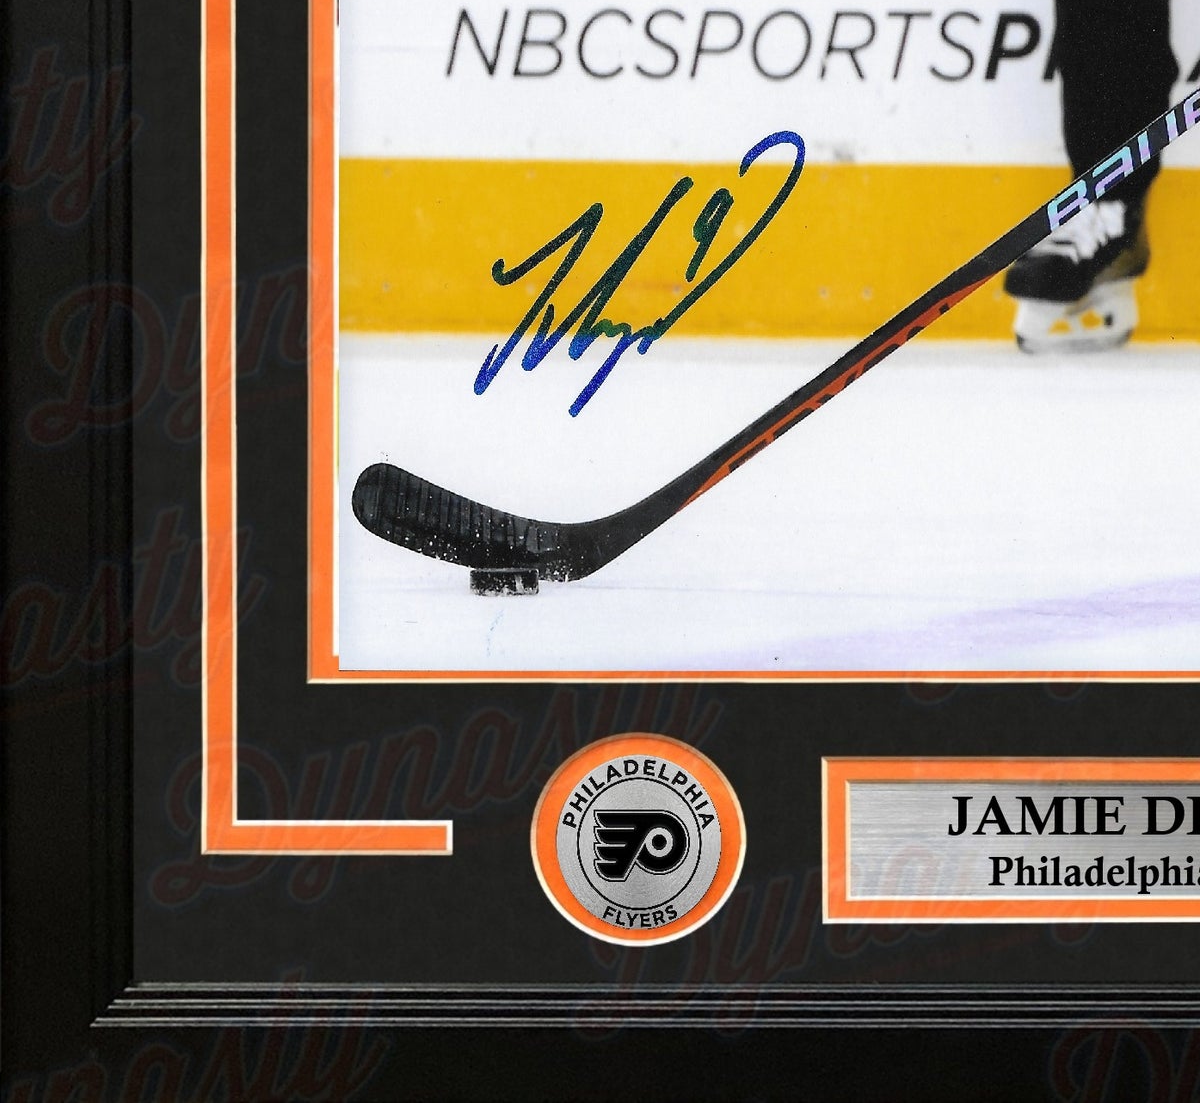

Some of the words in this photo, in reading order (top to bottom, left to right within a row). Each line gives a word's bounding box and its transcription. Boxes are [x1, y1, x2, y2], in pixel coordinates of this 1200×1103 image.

[562, 759, 715, 830] PHILADELPHIA
[947, 795, 1127, 837] JAMIE
[602, 904, 677, 928] FLYERS
